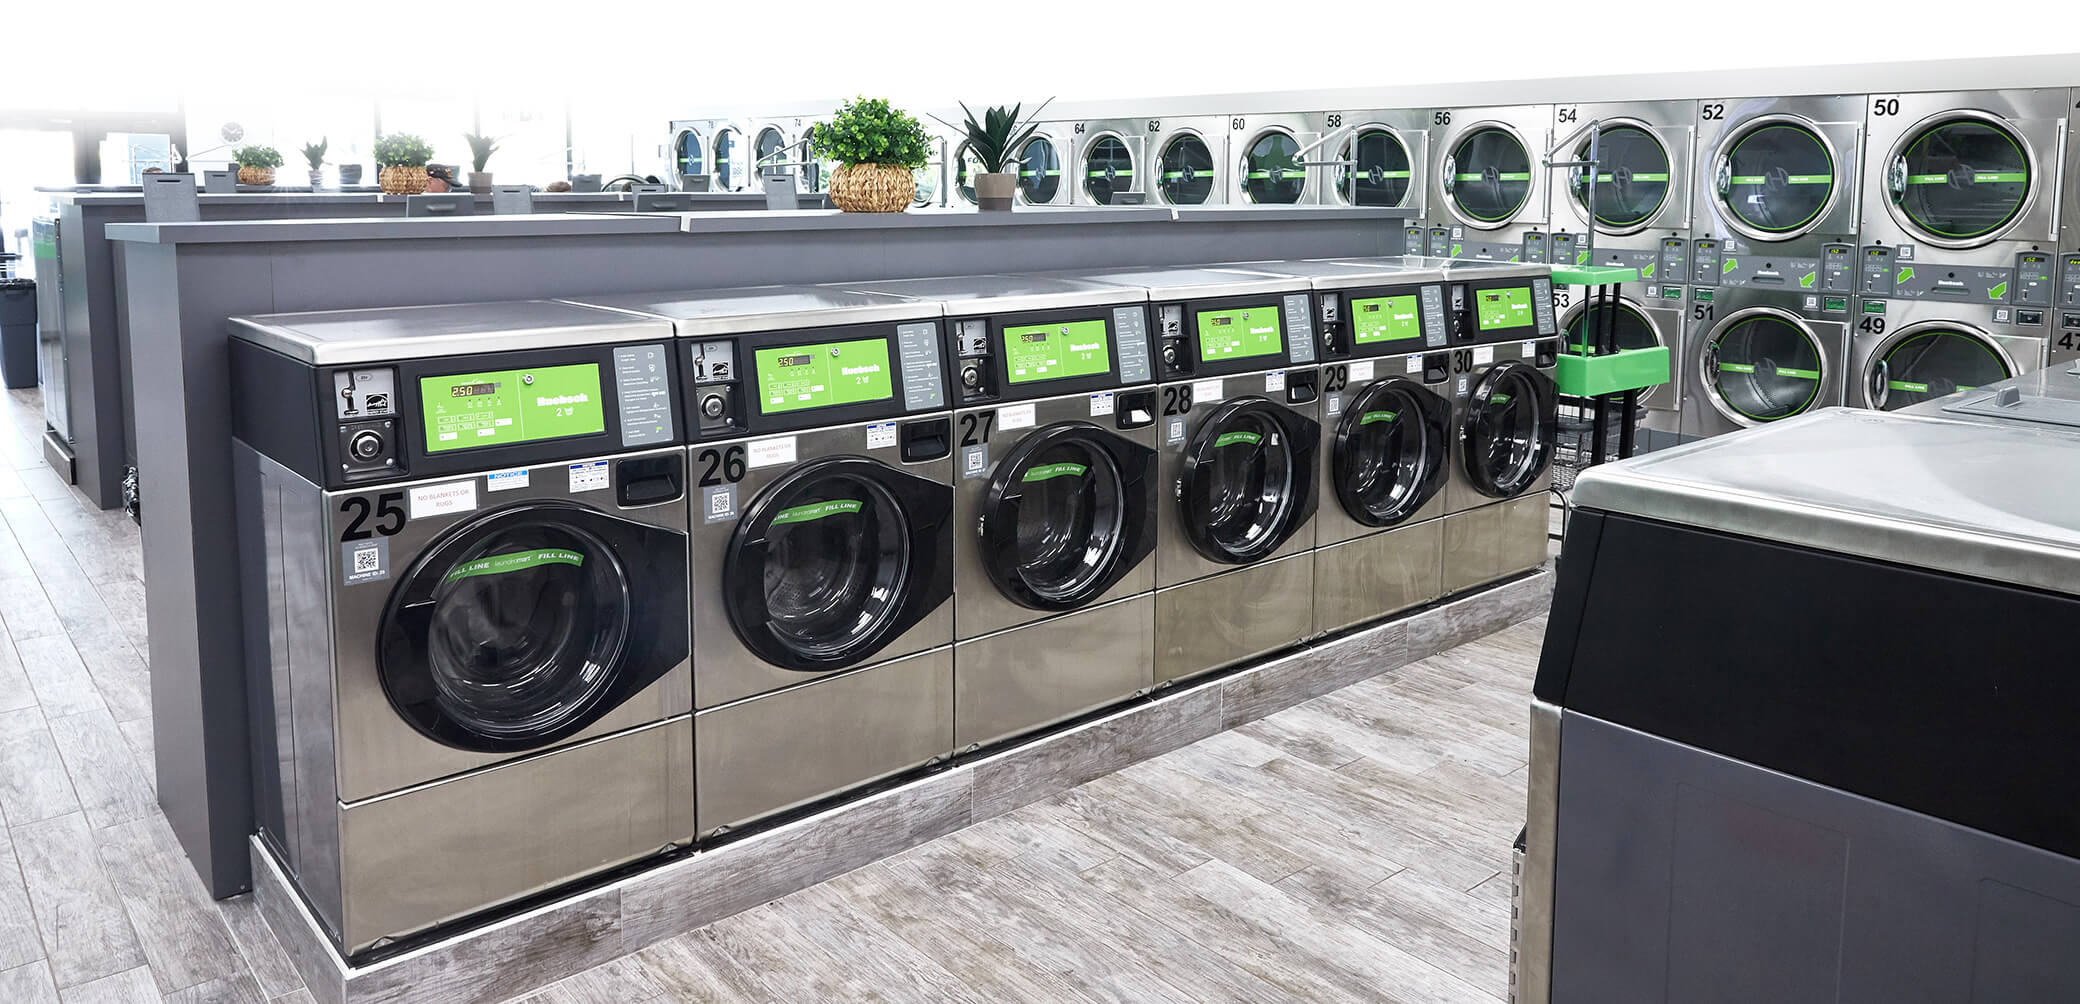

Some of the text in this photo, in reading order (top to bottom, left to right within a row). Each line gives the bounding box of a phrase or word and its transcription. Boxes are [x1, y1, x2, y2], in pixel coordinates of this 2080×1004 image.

[1702, 104, 1724, 121] 52
[1873, 98, 1900, 116] 50
[1328, 115, 1342, 128] 58
[1434, 112, 1451, 126] 56
[1558, 108, 1577, 123] 54
[1074, 123, 1085, 134] 64
[1148, 120, 1160, 132] 62
[1232, 119, 1245, 130] 60
[1694, 304, 1714, 321] 51
[1859, 316, 1886, 335] 49
[1454, 349, 1473, 374] 30
[1324, 365, 1347, 393] 29
[536, 393, 589, 406] Huebsch
[1163, 384, 1192, 417] 28
[555, 408, 562, 417] 2
[960, 410, 996, 447] 27
[698, 446, 746, 488] 26
[418, 488, 470, 502] NO BLANKETS OR
[435, 499, 453, 508] RUGS
[825, 503, 840, 512] FILL
[340, 491, 407, 542] 25
[449, 567, 467, 579] FILL
[468, 562, 490, 571] LINE
[558, 553, 580, 562] LINE
